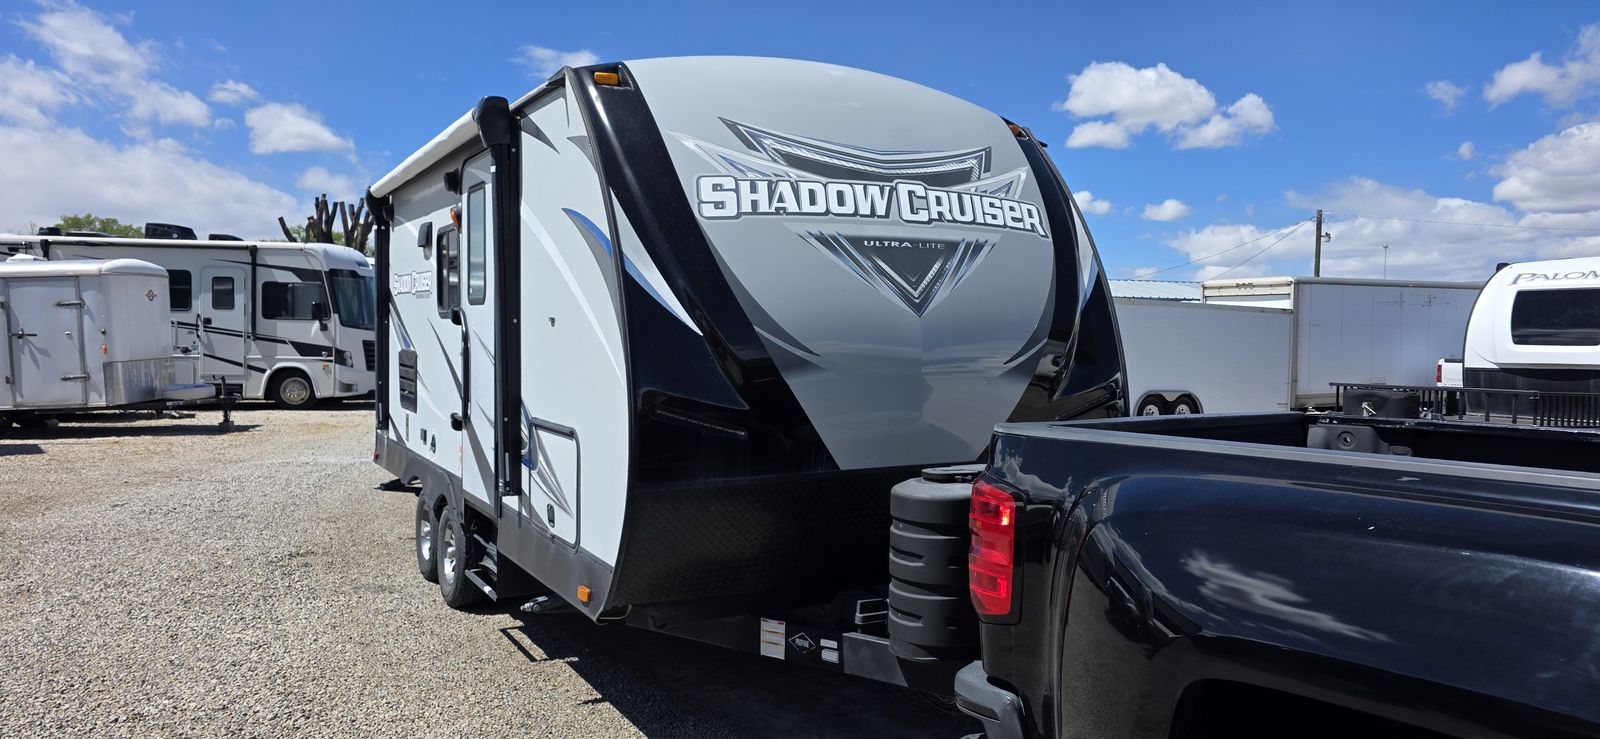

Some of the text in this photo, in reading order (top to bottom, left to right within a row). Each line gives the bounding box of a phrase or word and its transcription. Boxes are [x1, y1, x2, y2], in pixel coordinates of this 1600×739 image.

[699, 175, 1047, 237] SHADOW CRUISER
[863, 239, 946, 250] ULTRA-LITE
